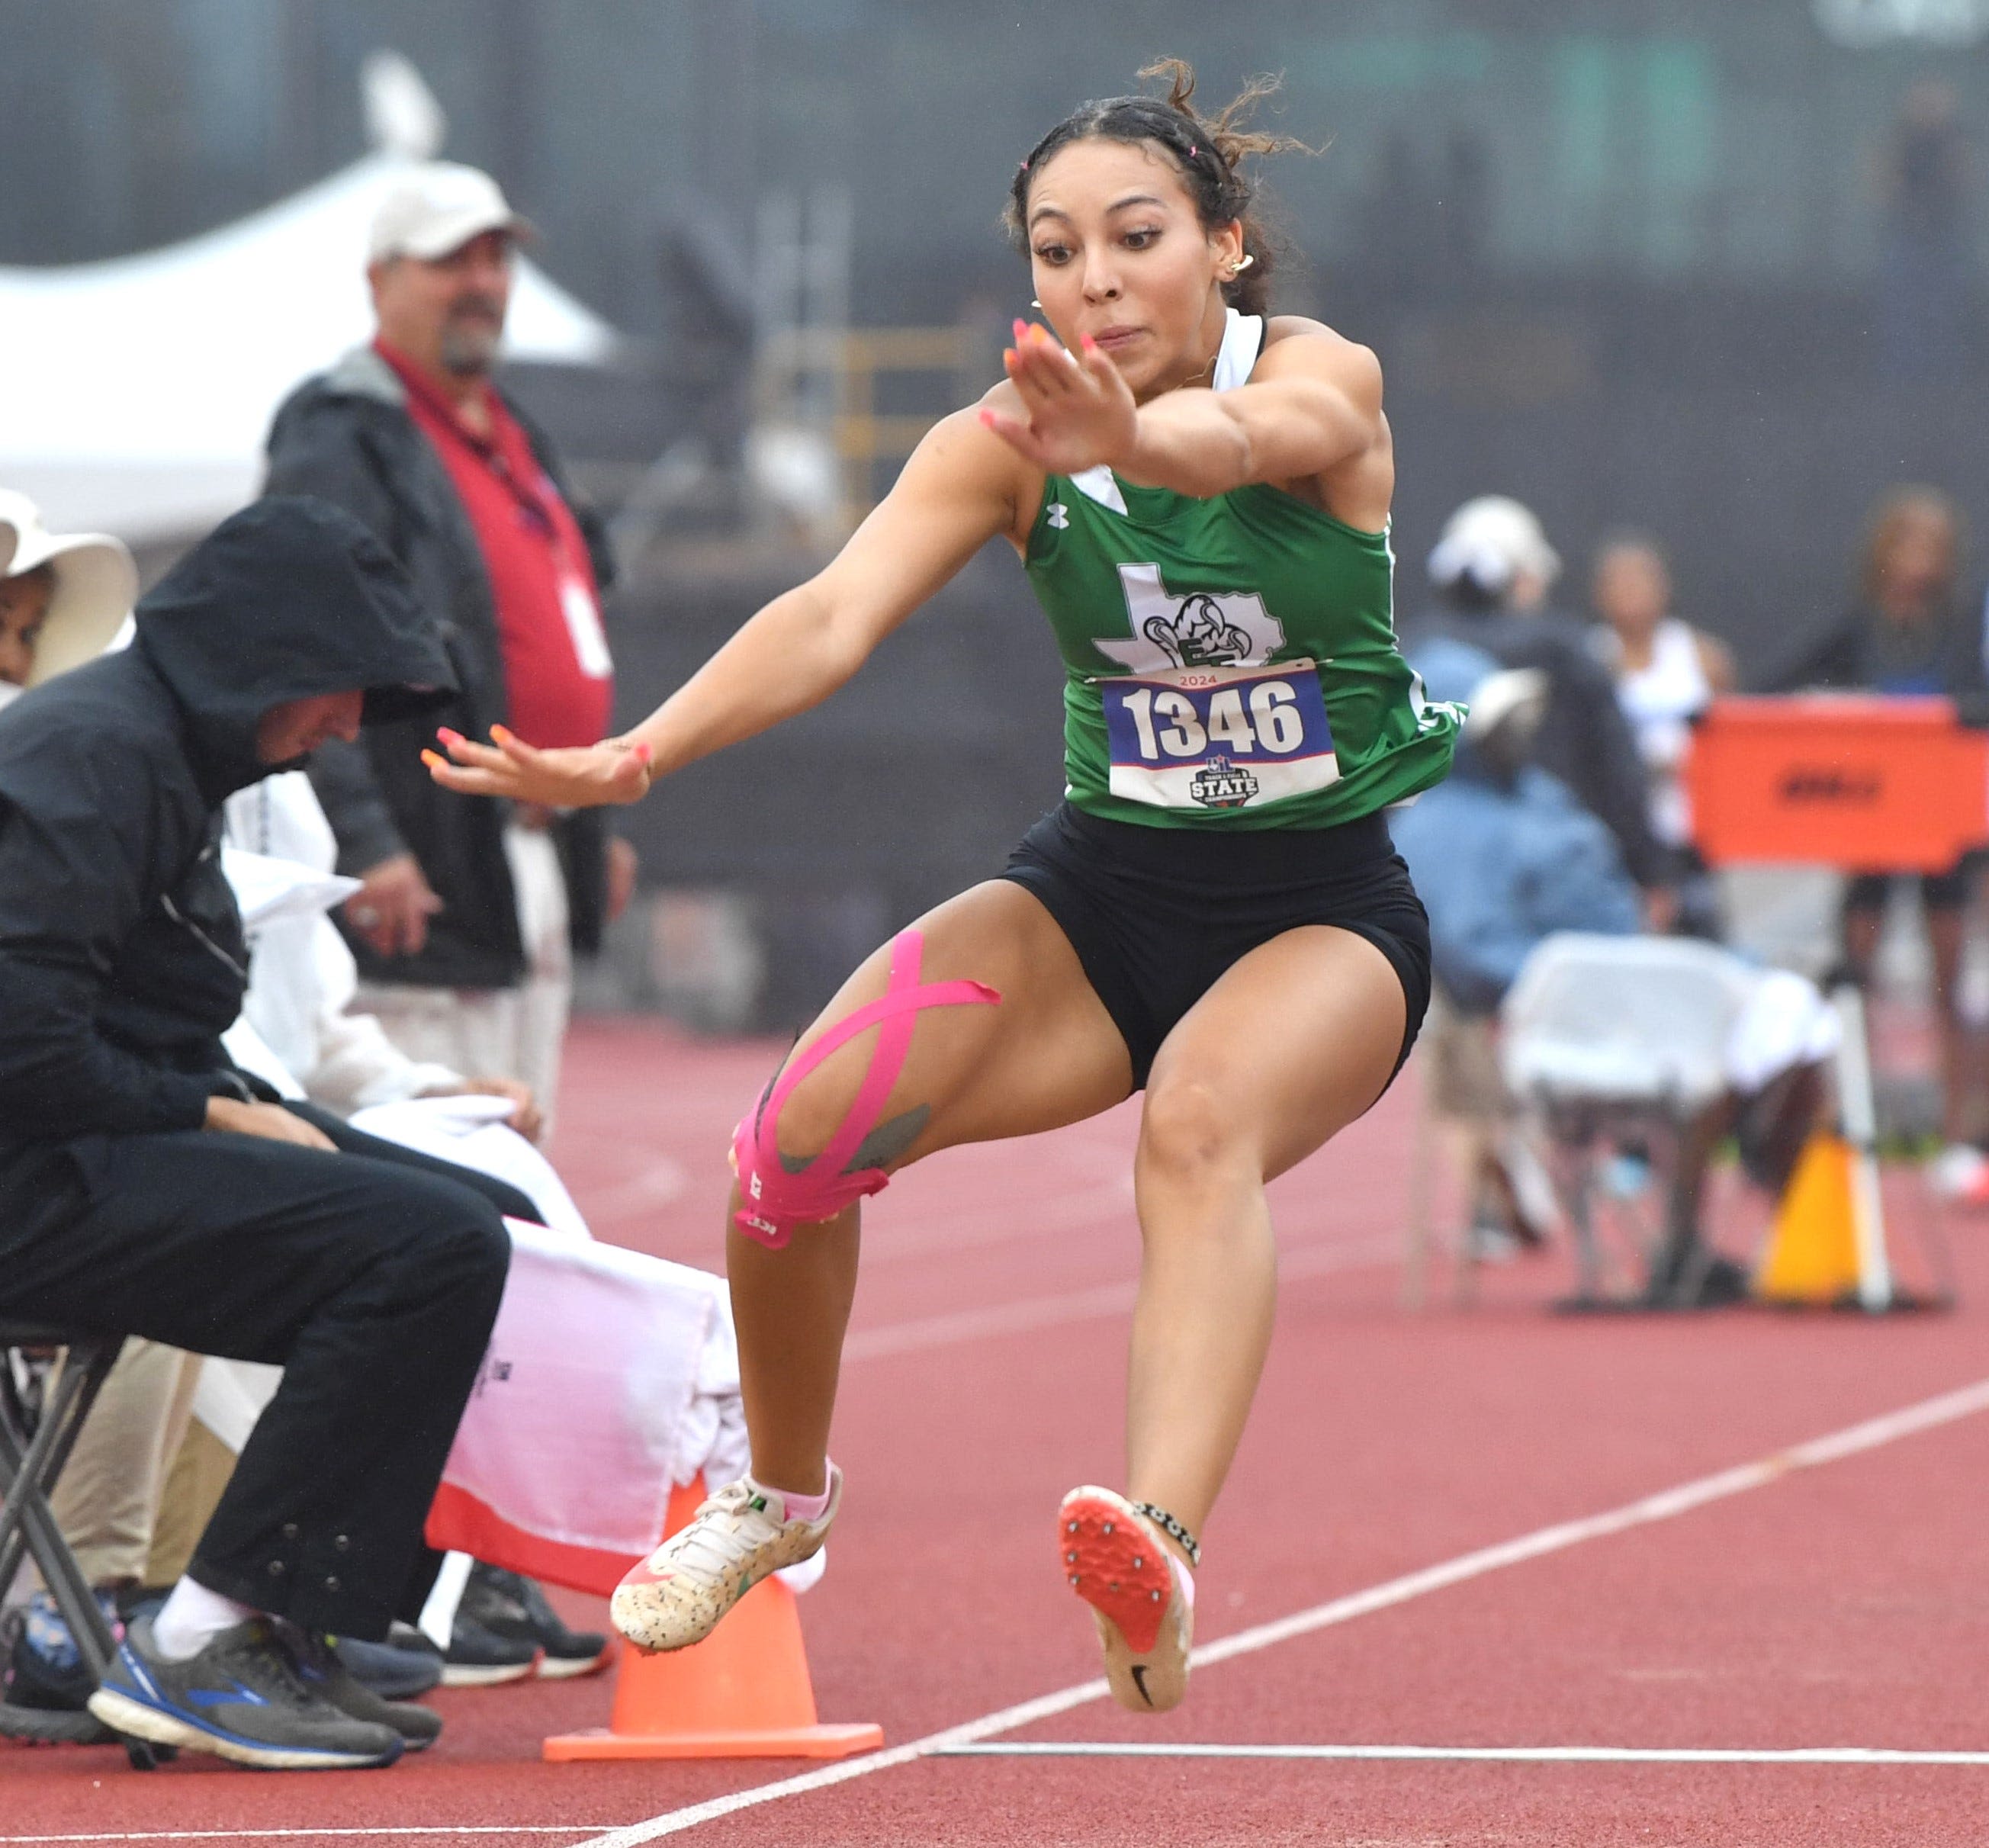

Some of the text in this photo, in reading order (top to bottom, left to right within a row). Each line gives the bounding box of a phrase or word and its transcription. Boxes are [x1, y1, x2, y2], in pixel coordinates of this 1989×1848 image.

[1181, 675, 1217, 686] 2024
[1122, 680, 1304, 760] 1346
[1191, 778, 1258, 798] STATE
